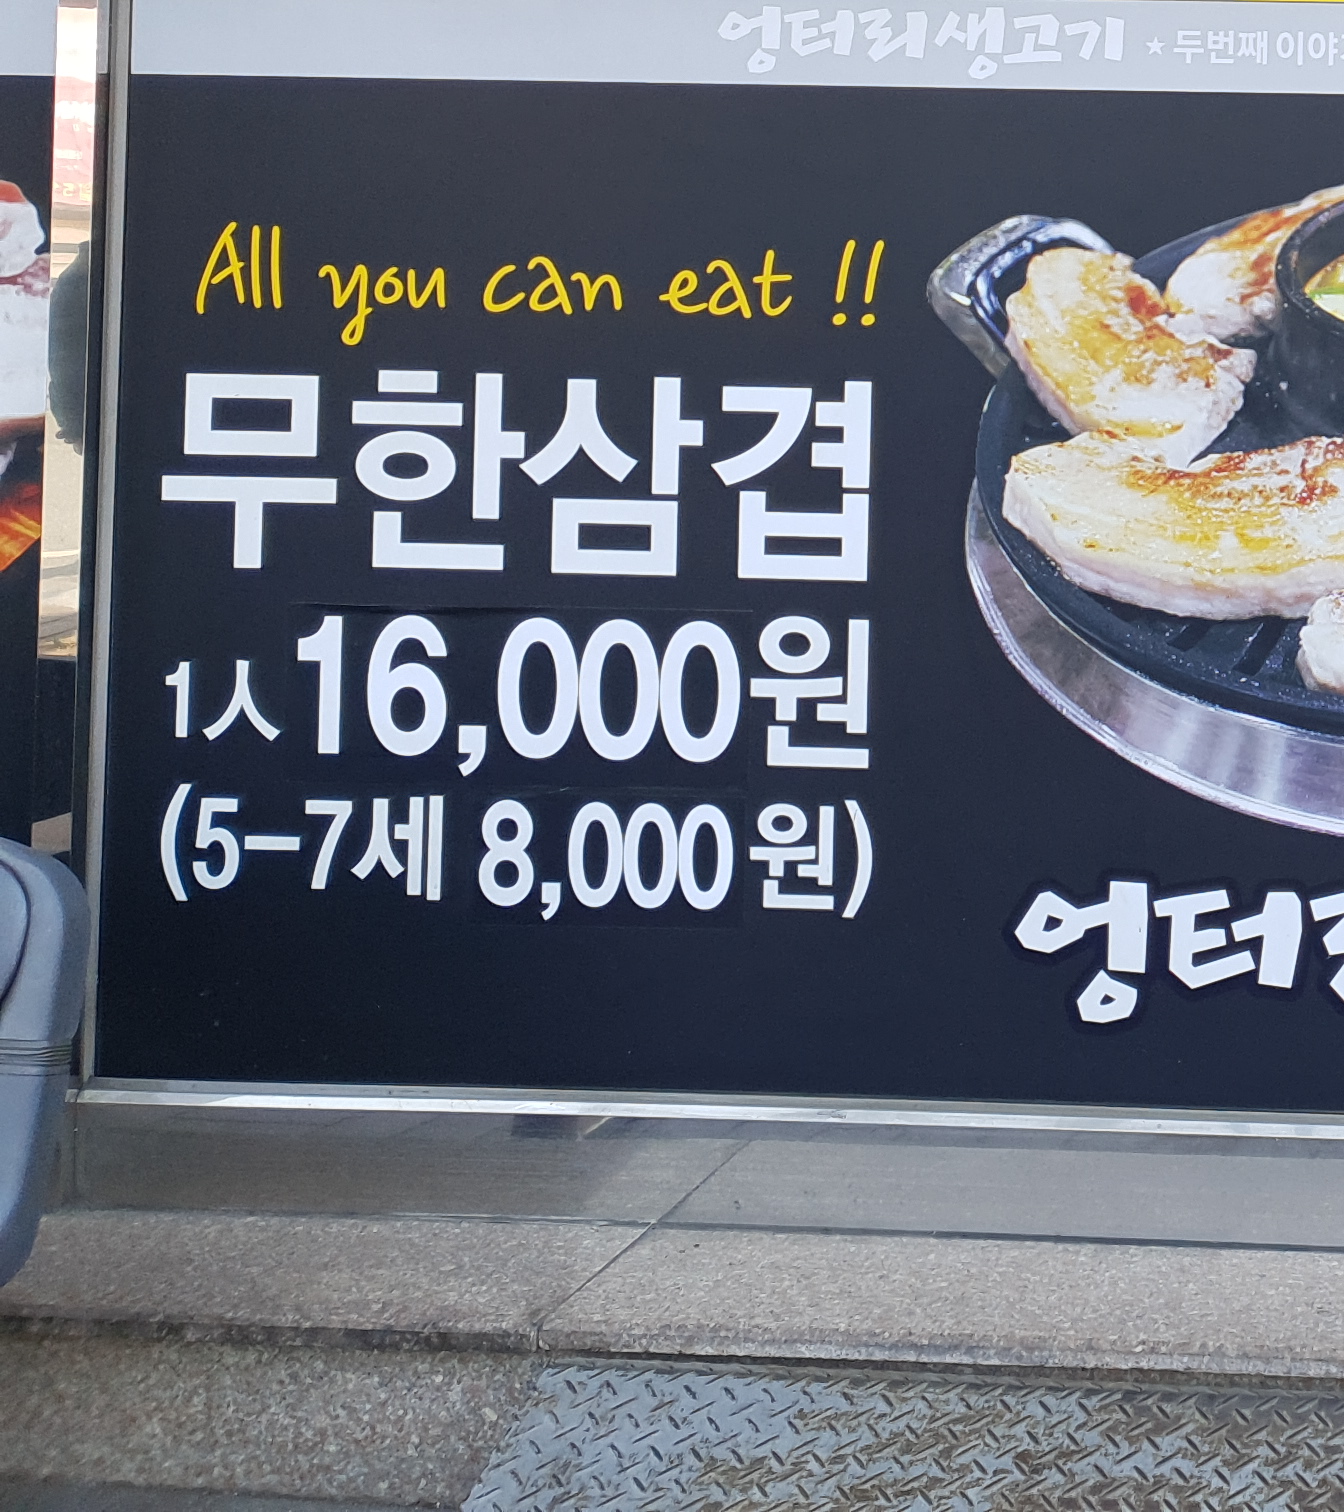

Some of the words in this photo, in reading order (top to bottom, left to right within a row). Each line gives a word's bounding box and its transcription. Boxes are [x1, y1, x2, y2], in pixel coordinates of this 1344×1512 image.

[718, 6, 1125, 80] 엉터리생고기
[1172, 30, 1268, 66] 두번째
[195, 221, 282, 314] All
[317, 259, 448, 347] you
[482, 255, 624, 316] can
[659, 249, 794, 319] eat
[831, 239, 885, 327] !!
[161, 369, 873, 583] 무한삼겹
[296, 615, 872, 778] 16,000원
